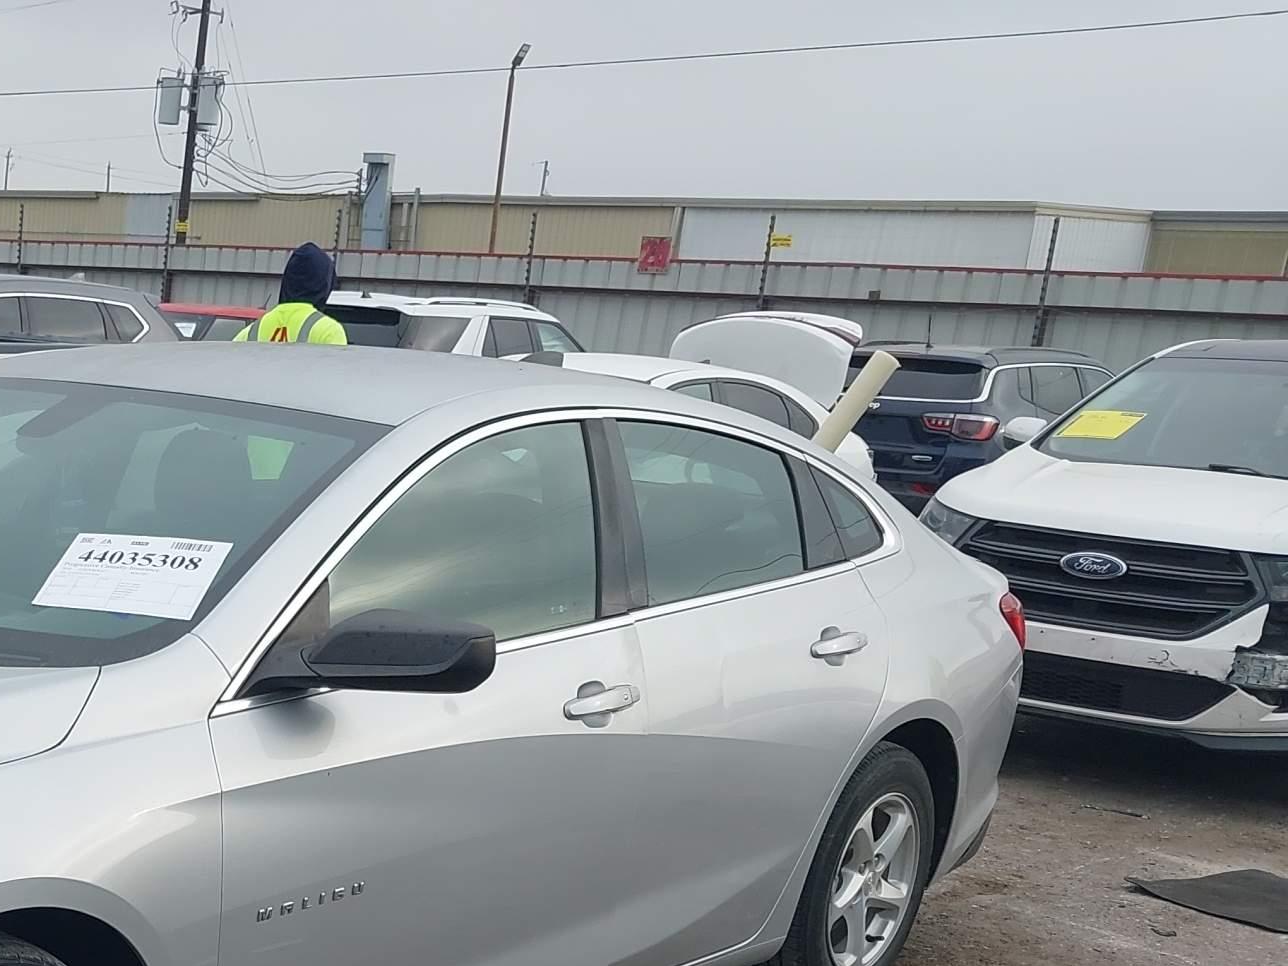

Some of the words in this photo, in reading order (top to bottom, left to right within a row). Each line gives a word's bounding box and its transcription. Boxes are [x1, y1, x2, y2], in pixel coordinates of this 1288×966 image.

[78, 549, 203, 571] 44035308
[1073, 556, 1112, 574] Ford
[256, 881, 365, 922] MALIBU
